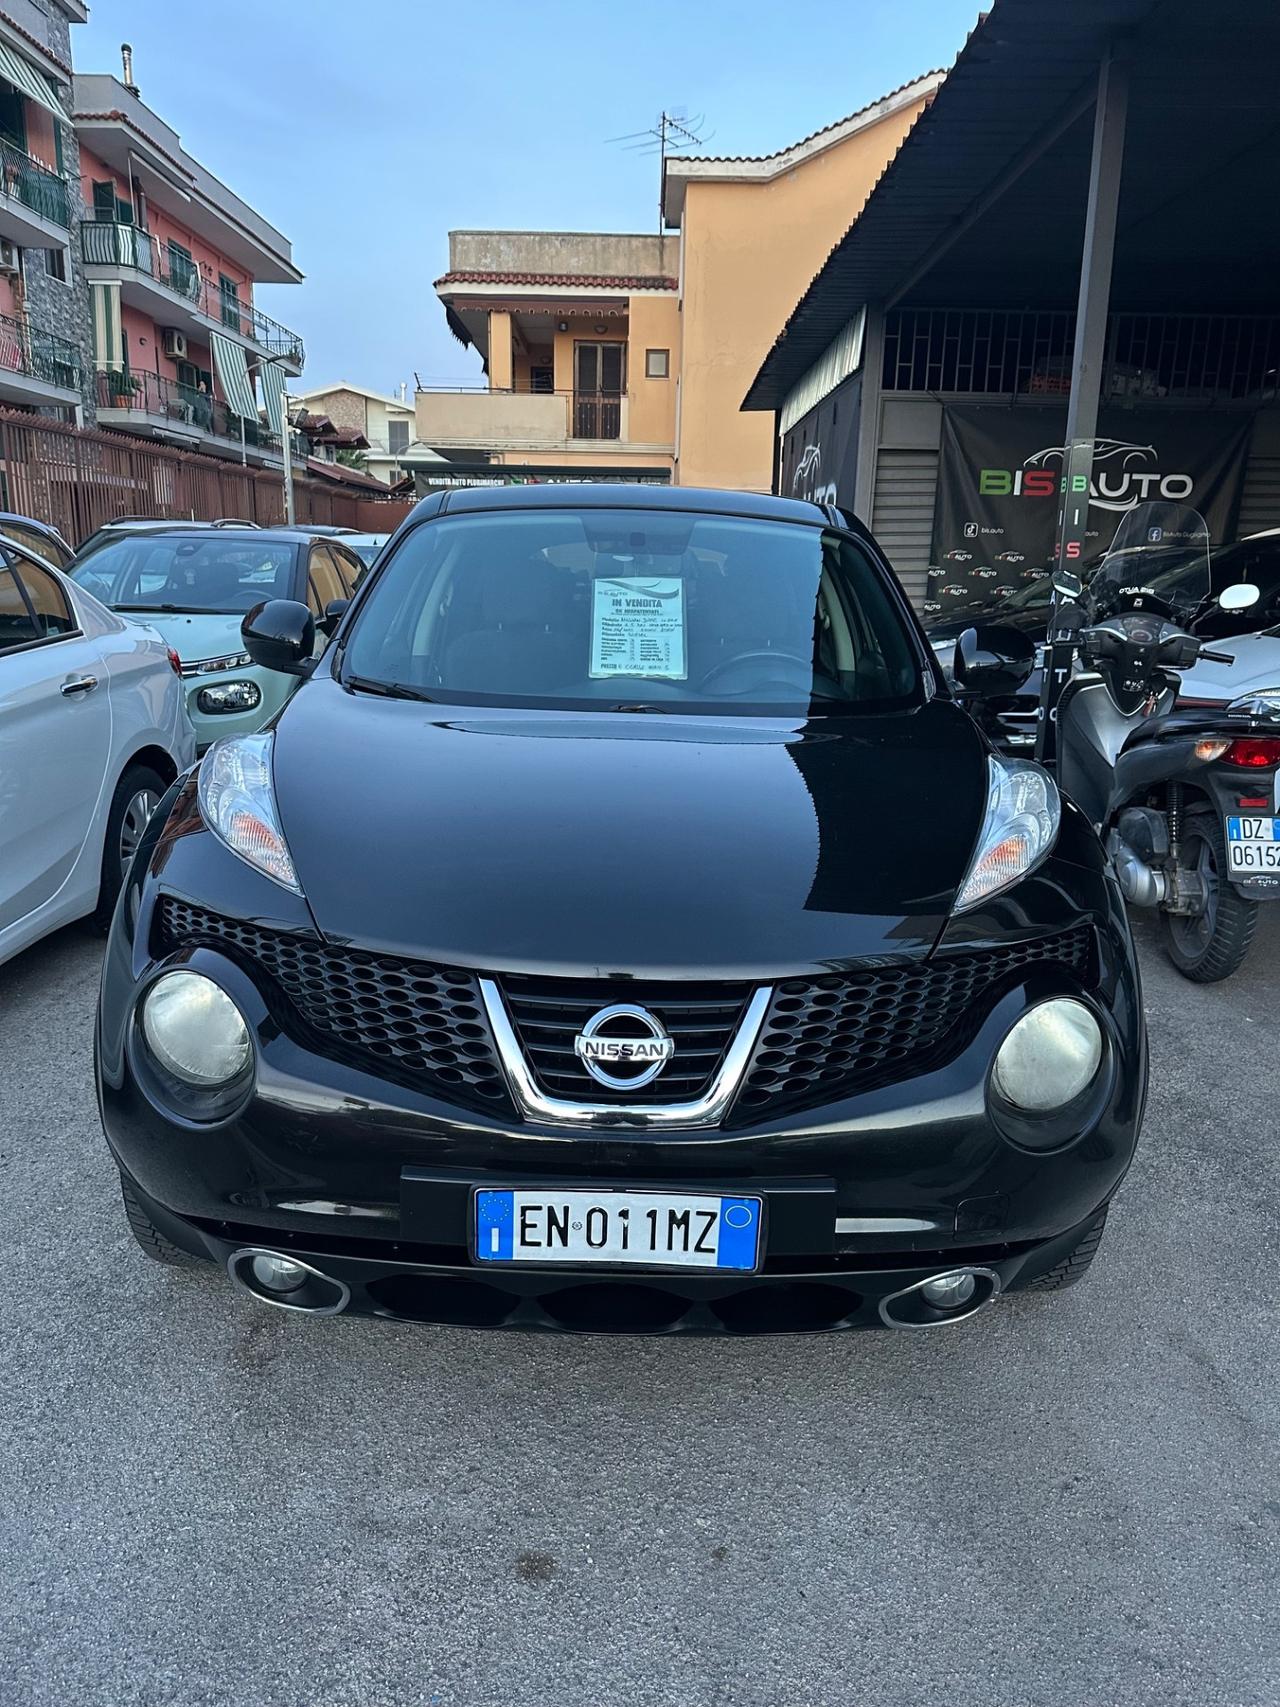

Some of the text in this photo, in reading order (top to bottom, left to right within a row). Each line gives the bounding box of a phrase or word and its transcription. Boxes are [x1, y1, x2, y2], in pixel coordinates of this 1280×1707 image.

[428, 477, 451, 485] VENDITA
[452, 478, 466, 486] AUTO
[979, 470, 1194, 499] BIS UTO
[625, 598, 663, 608] VENDITA
[1242, 818, 1264, 839] DZ
[584, 1041, 665, 1057] NISSAN
